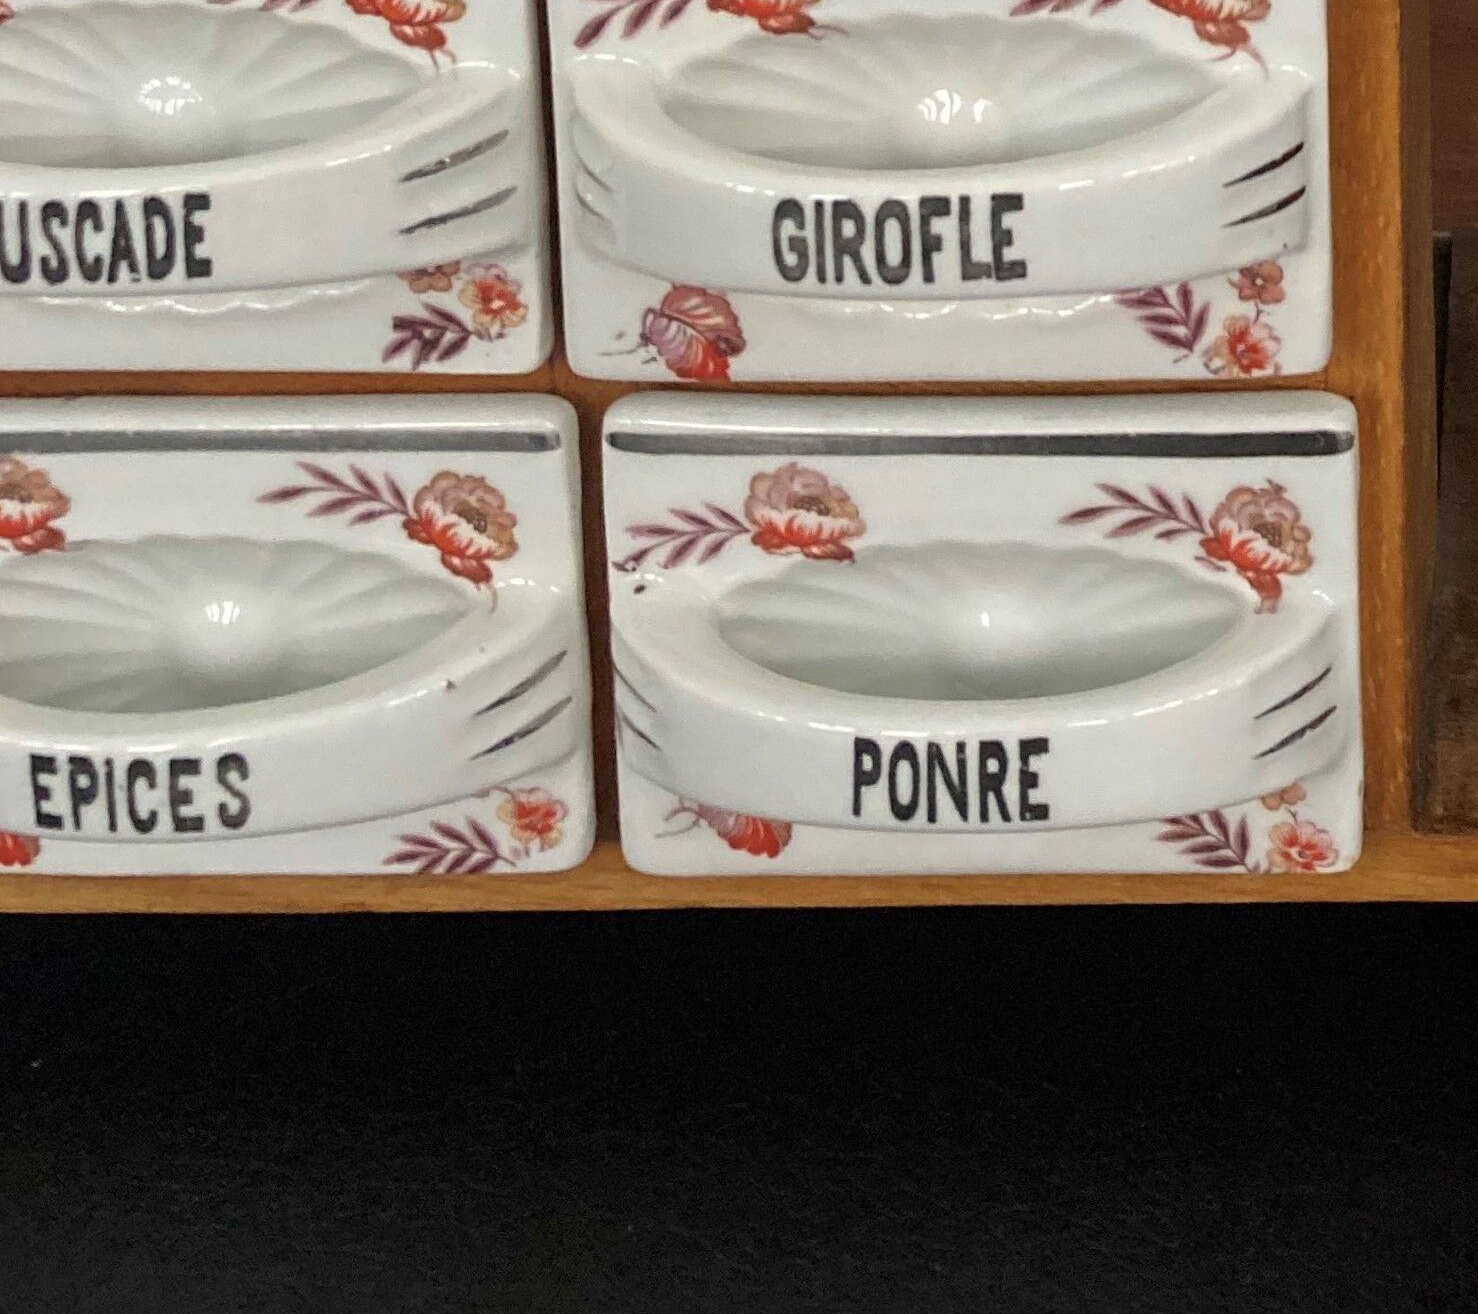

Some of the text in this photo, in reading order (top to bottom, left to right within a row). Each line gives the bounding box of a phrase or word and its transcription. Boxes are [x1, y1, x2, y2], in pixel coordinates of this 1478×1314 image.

[0, 192, 213, 286] USCADE
[771, 192, 1028, 286] GIROFLE
[29, 751, 252, 835] EPICES
